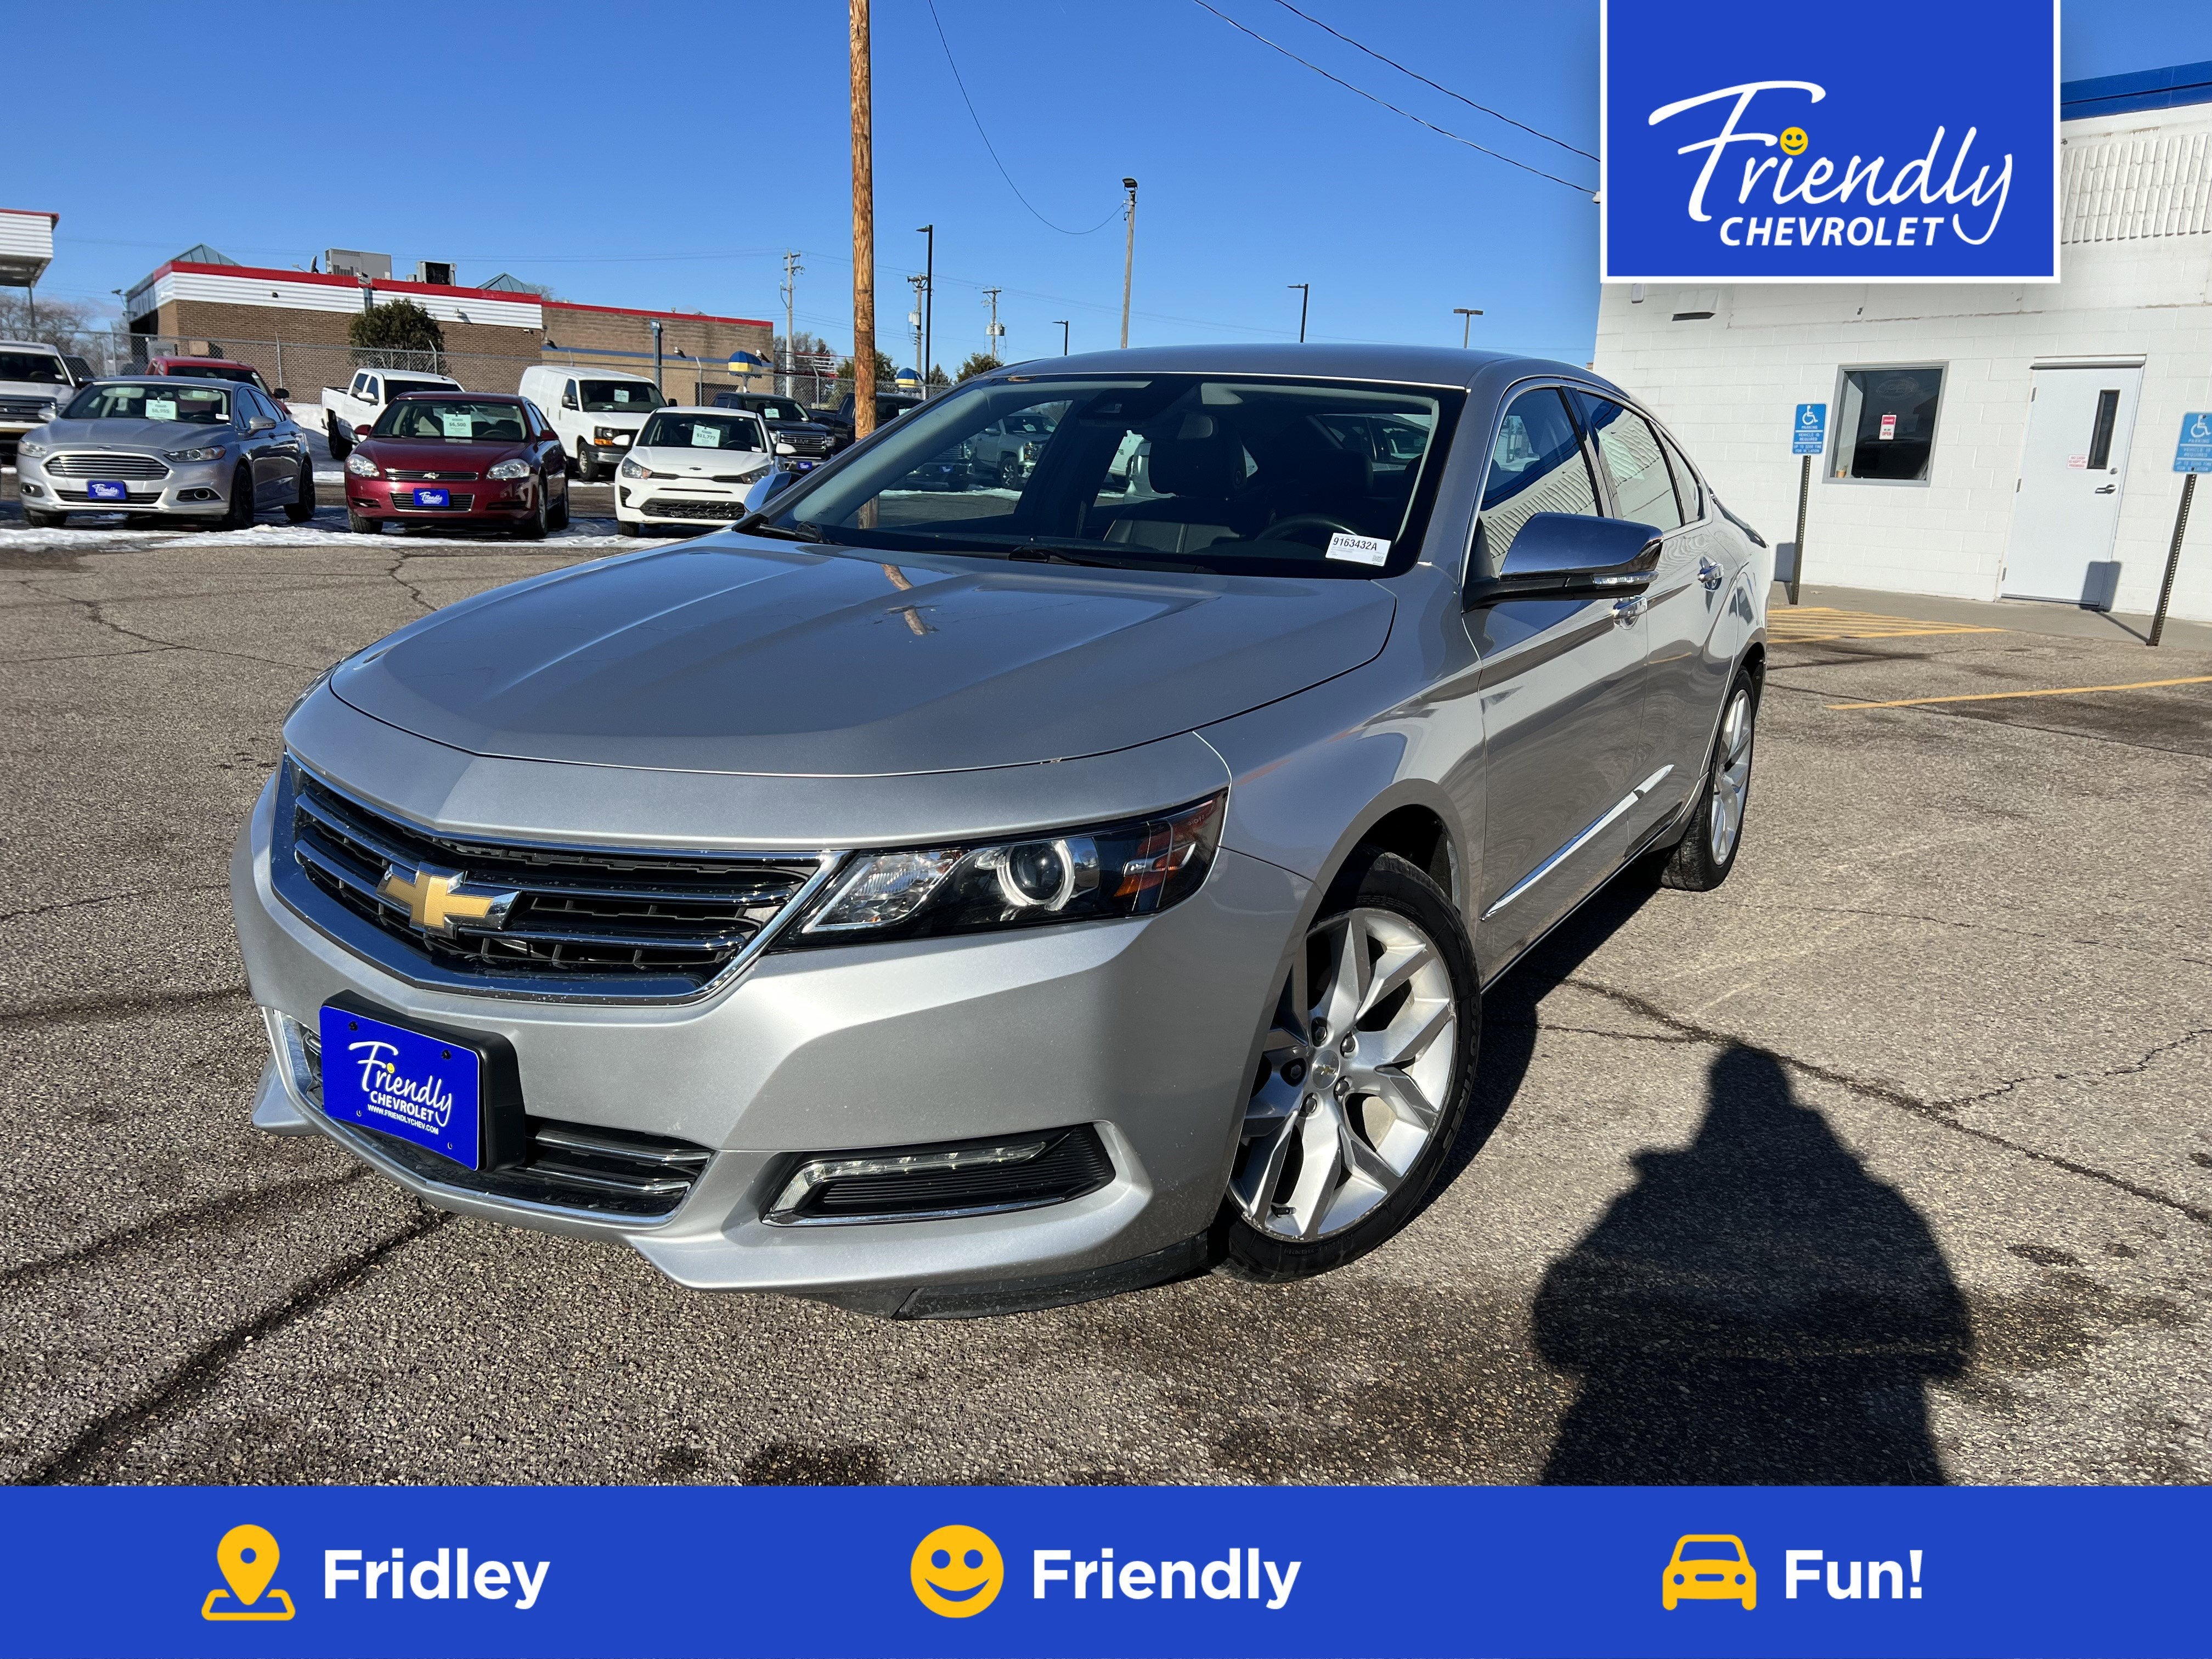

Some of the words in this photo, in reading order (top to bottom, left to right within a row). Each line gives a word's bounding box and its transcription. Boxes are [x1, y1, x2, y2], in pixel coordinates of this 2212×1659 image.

[419, 492, 443, 503] Friendly
[1333, 537, 1378, 551] 9163432A
[1470, 980, 1480, 1057] OYO
[348, 1041, 452, 1127] Friendly
[367, 1104, 439, 1135] WWW.FRIENDLYCHEV.COM
[370, 1090, 435, 1122] CHEVROLET
